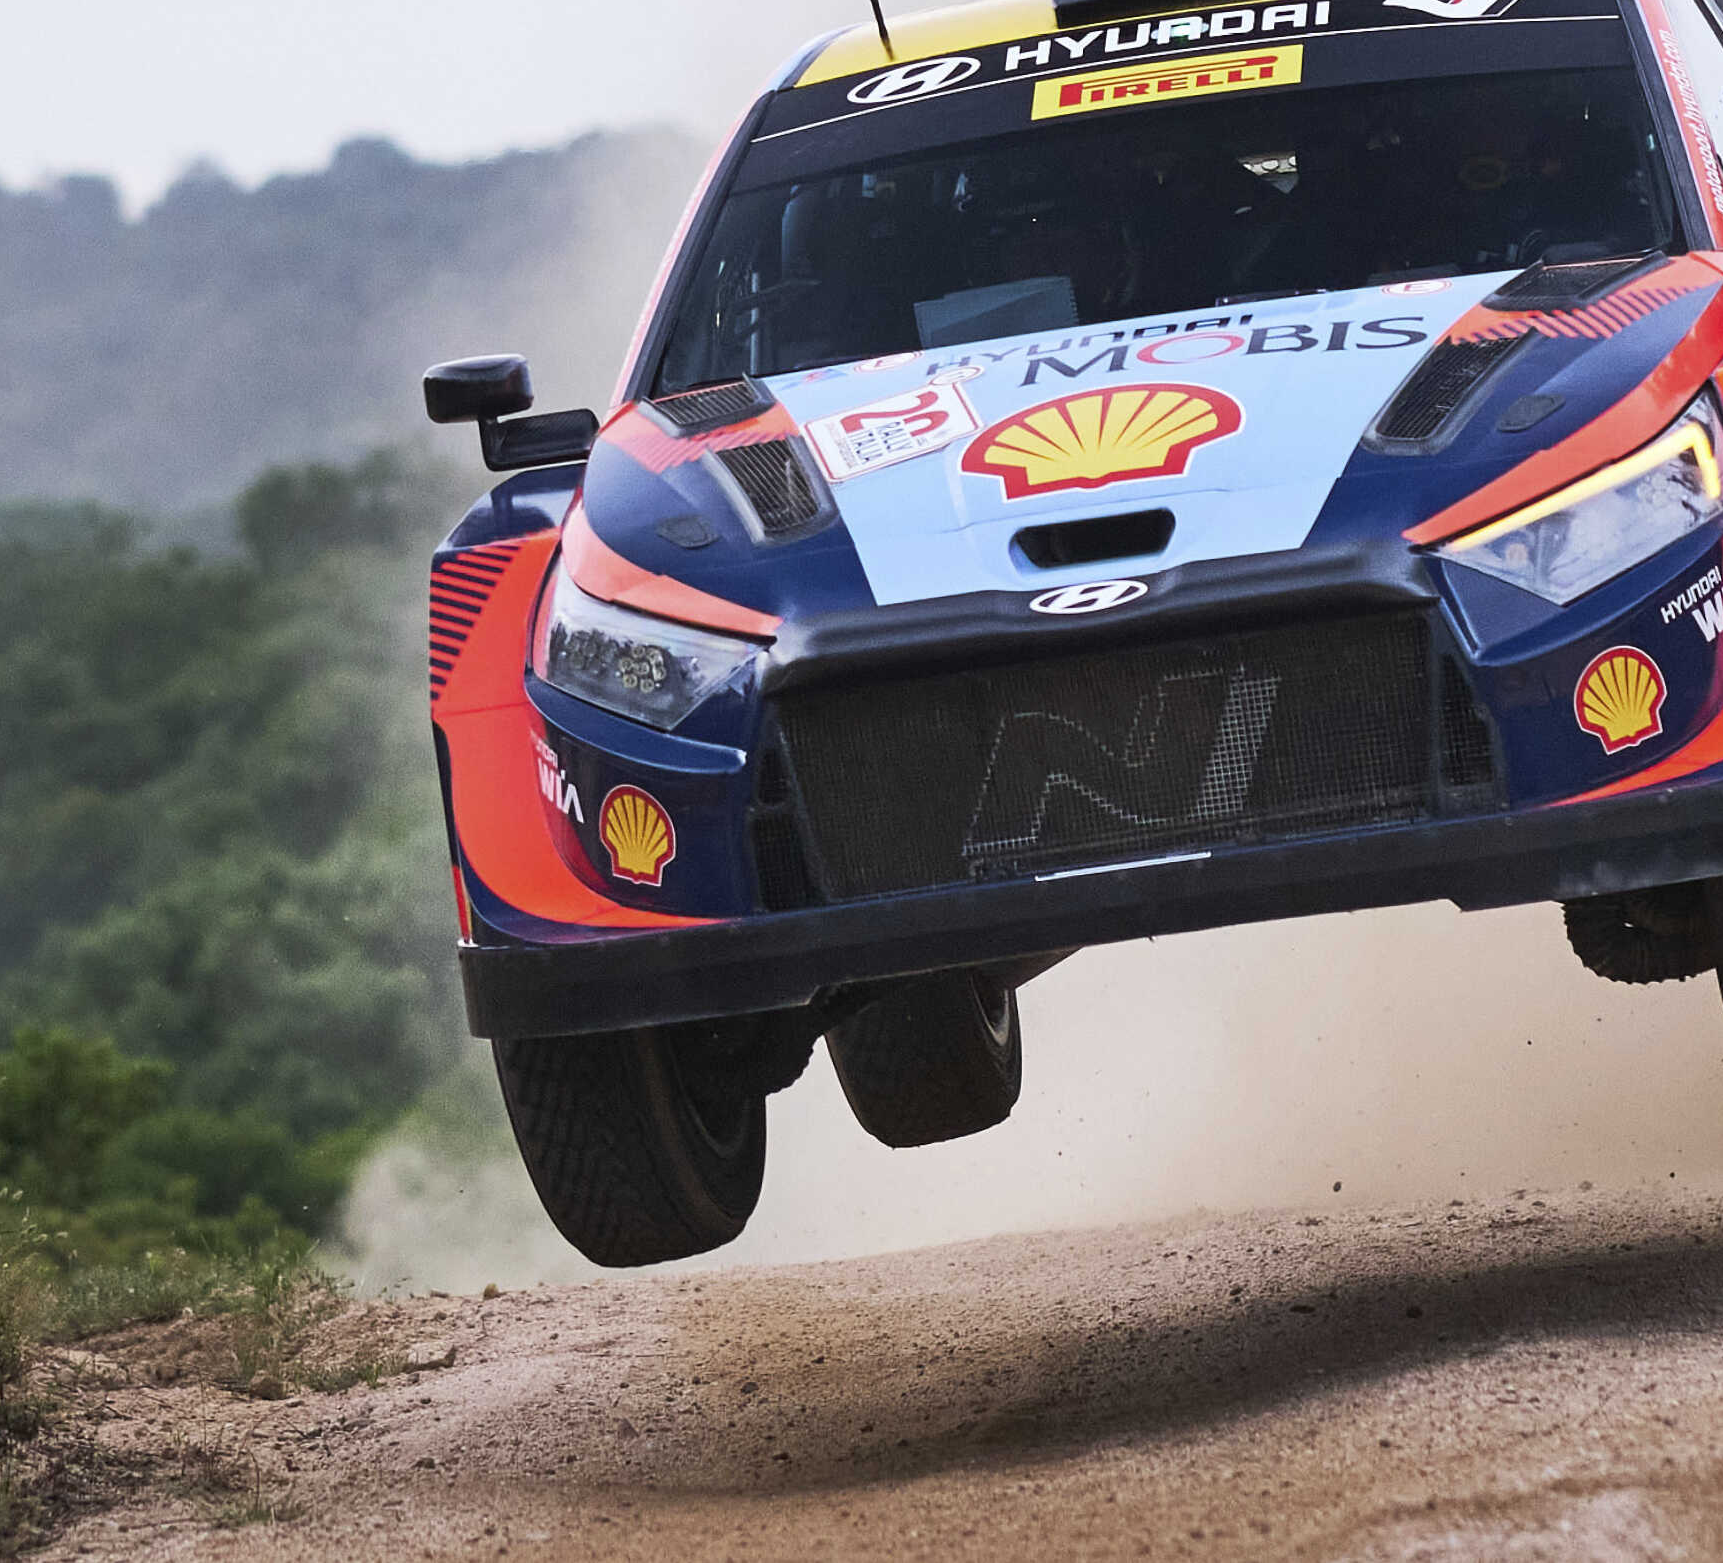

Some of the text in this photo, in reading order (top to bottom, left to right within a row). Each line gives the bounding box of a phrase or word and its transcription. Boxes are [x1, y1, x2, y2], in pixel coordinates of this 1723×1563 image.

[1005, 1, 1330, 71] HYUNDAI
[1059, 55, 1278, 108] PIRELLI
[926, 314, 1254, 376] HYUNDAI
[1019, 316, 1426, 387] MOBIS
[1660, 565, 1722, 624] HYUNDAI
